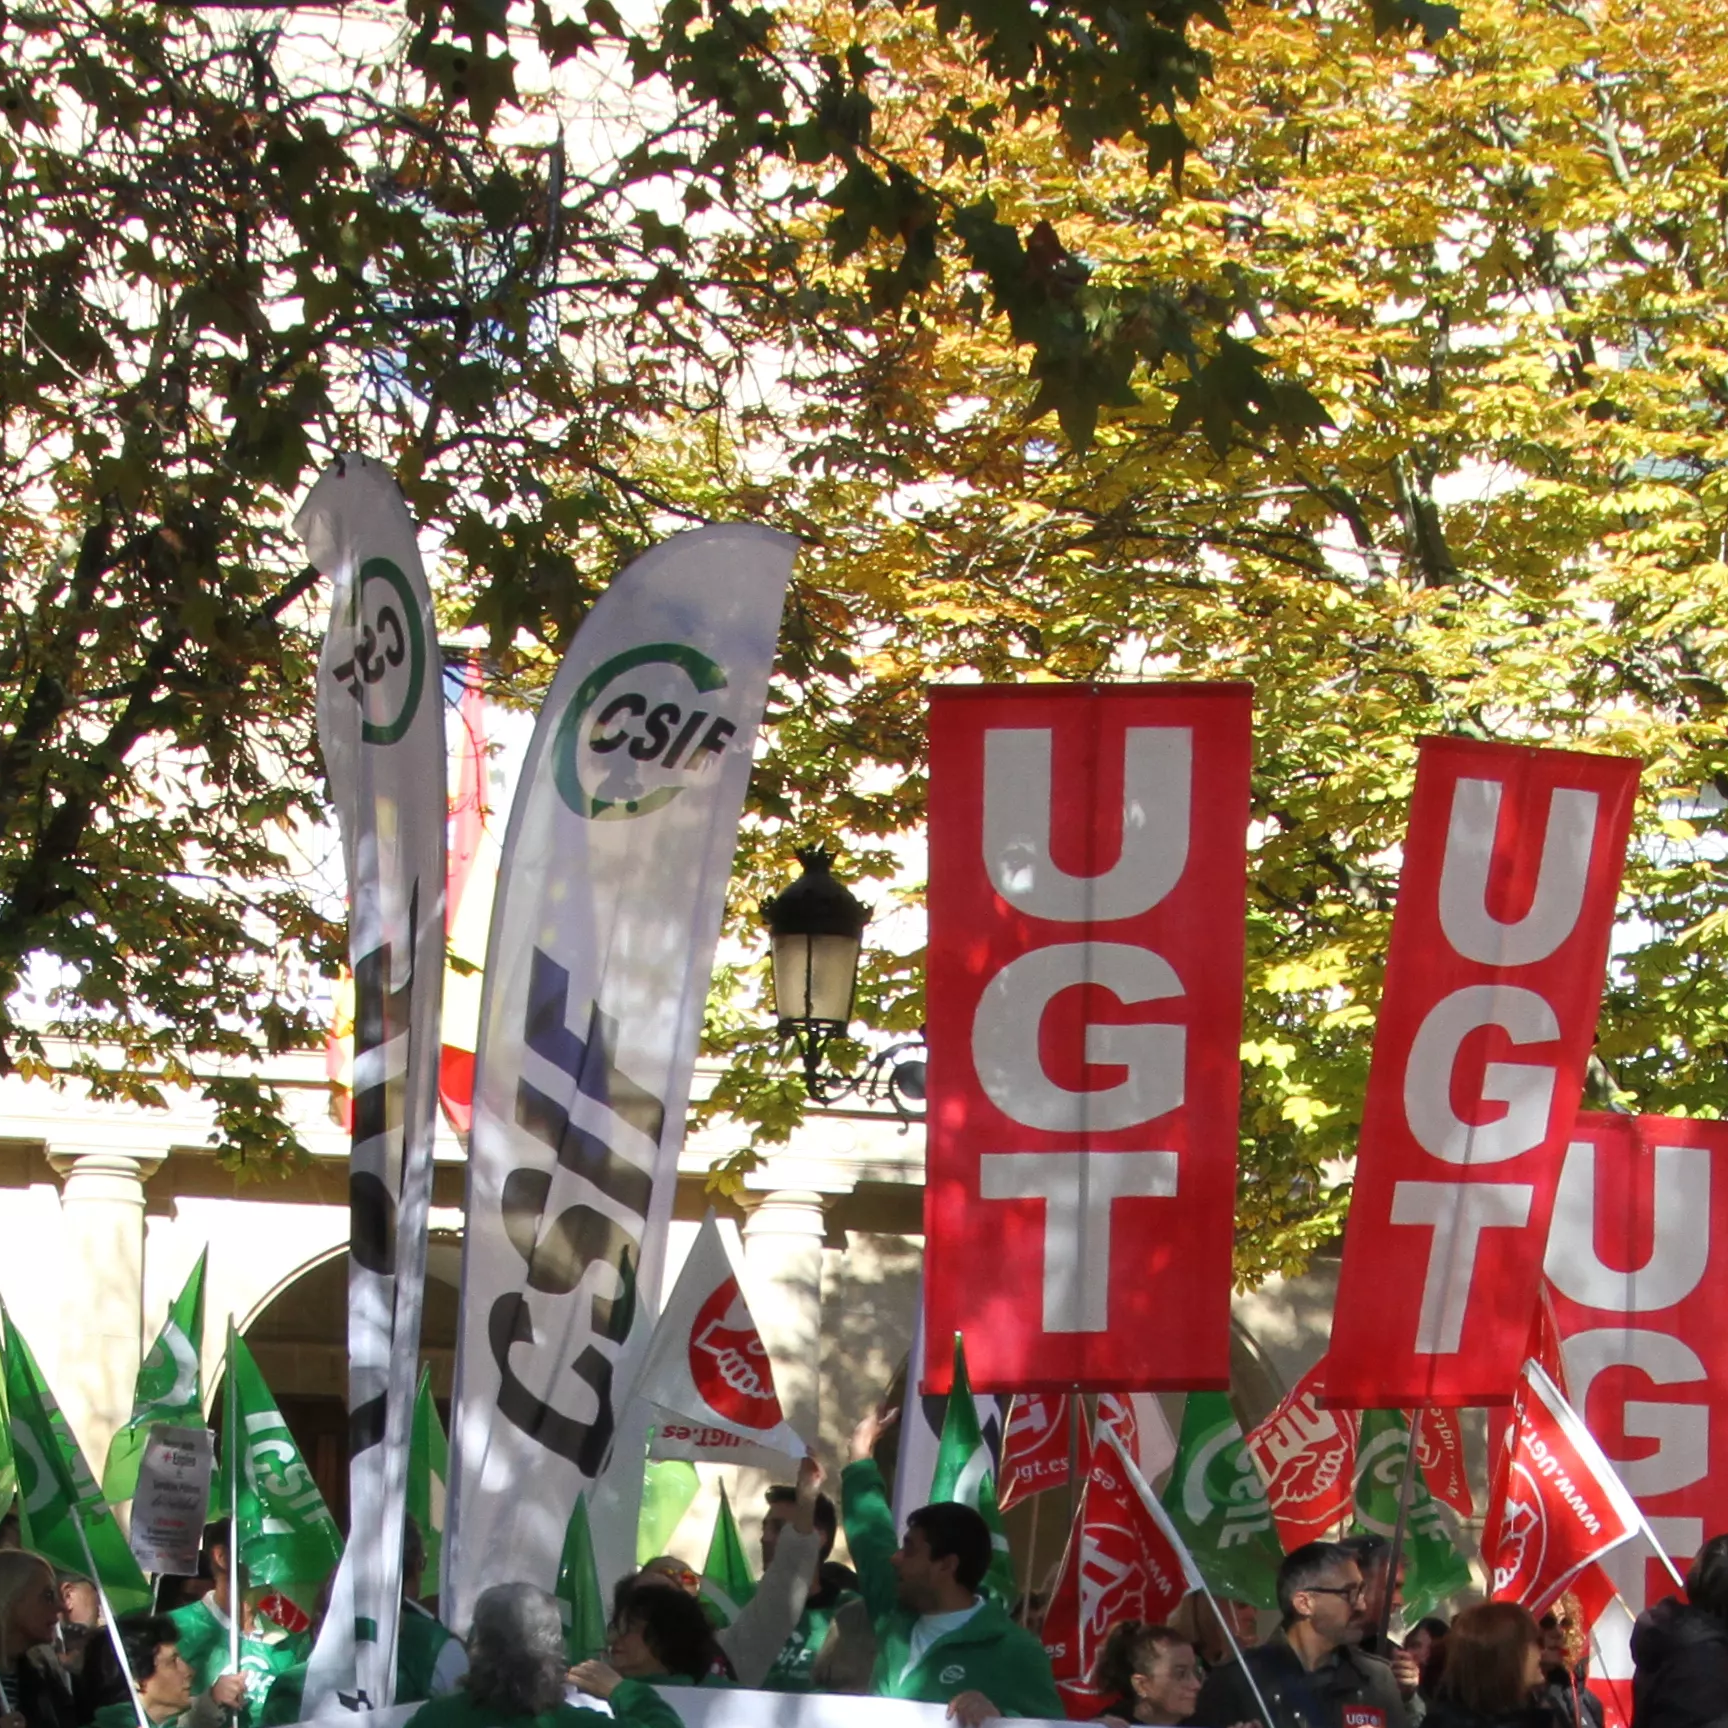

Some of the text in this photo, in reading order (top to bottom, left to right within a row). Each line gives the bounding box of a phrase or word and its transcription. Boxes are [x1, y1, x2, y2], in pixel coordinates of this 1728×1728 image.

[588, 692, 738, 773] CSIF
[970, 727, 1193, 1333] UGT
[1389, 776, 1599, 1356] UGT
